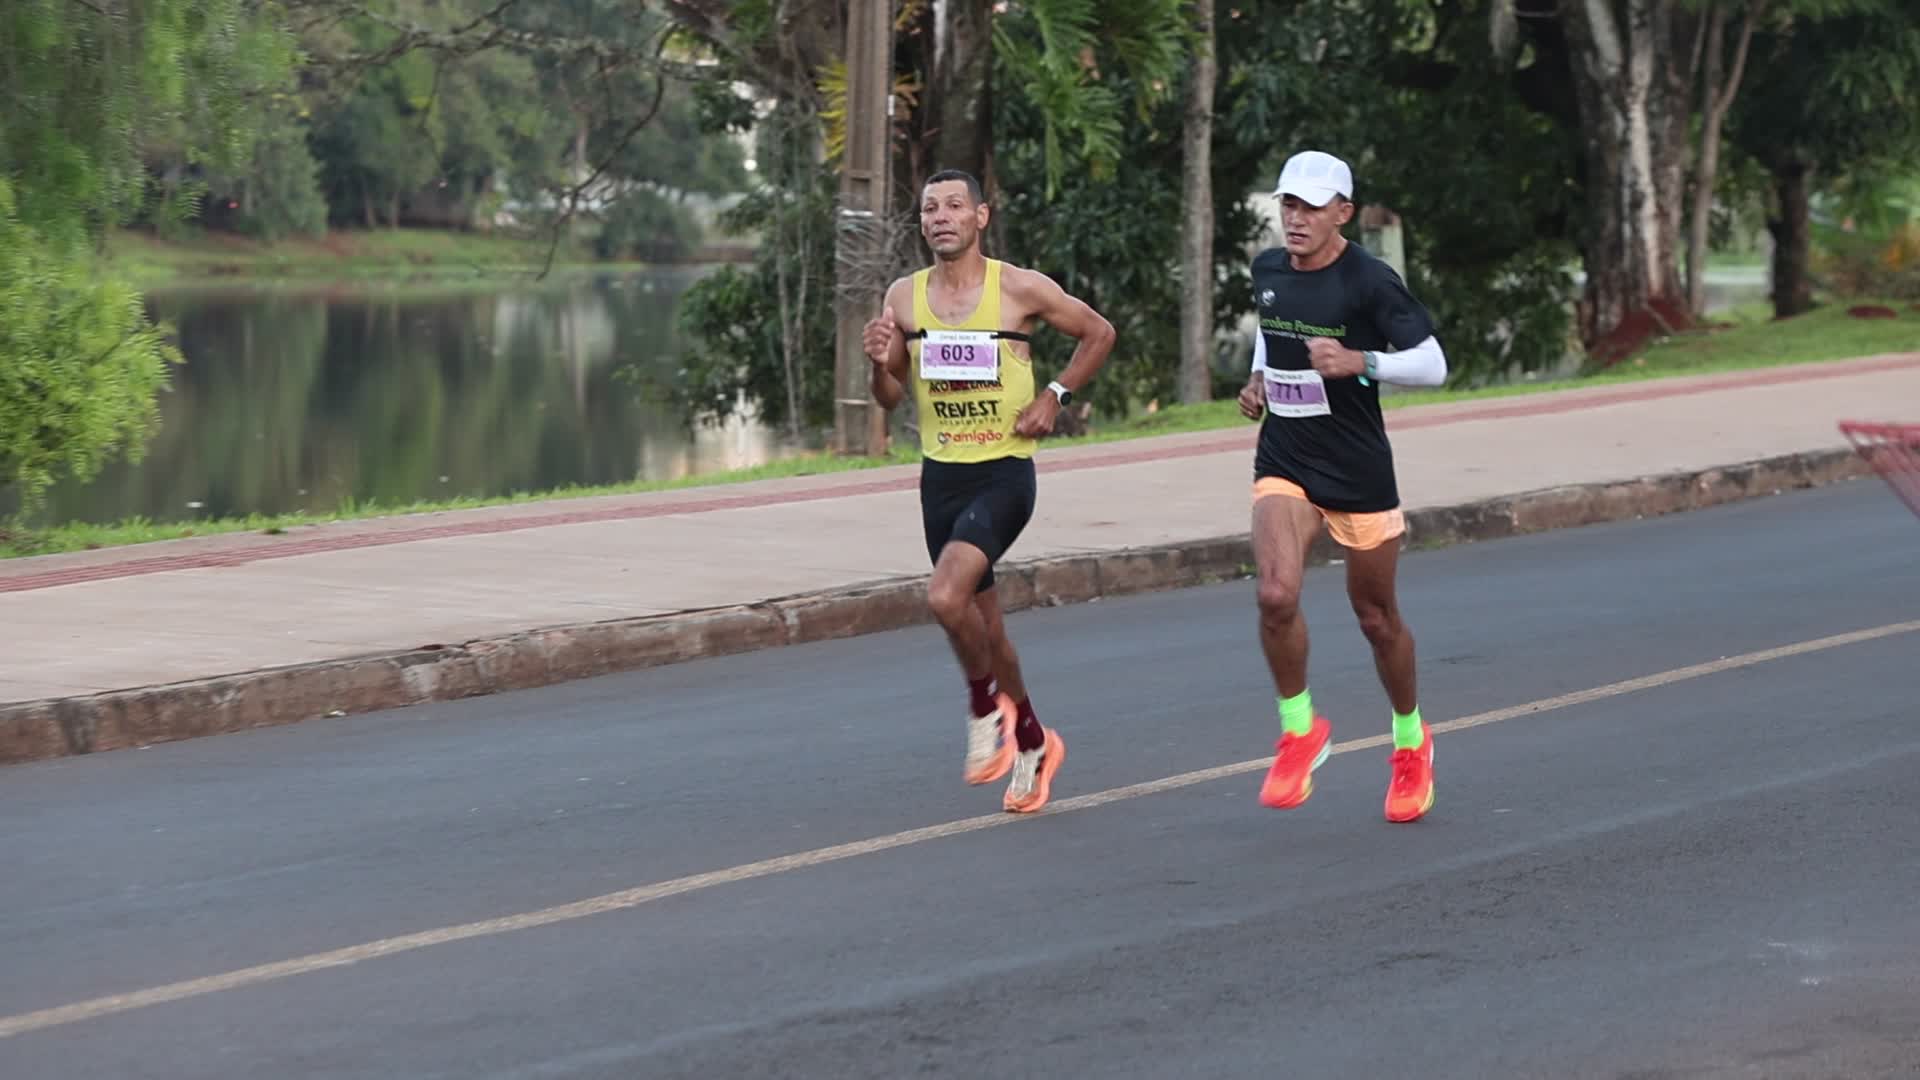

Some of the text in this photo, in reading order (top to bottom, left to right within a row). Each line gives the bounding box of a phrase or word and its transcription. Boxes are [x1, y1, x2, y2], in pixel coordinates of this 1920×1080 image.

[941, 344, 975, 362] 603
[1275, 381, 1303, 401] 771
[933, 400, 999, 418] REVEST
[953, 430, 1003, 444] amigão
